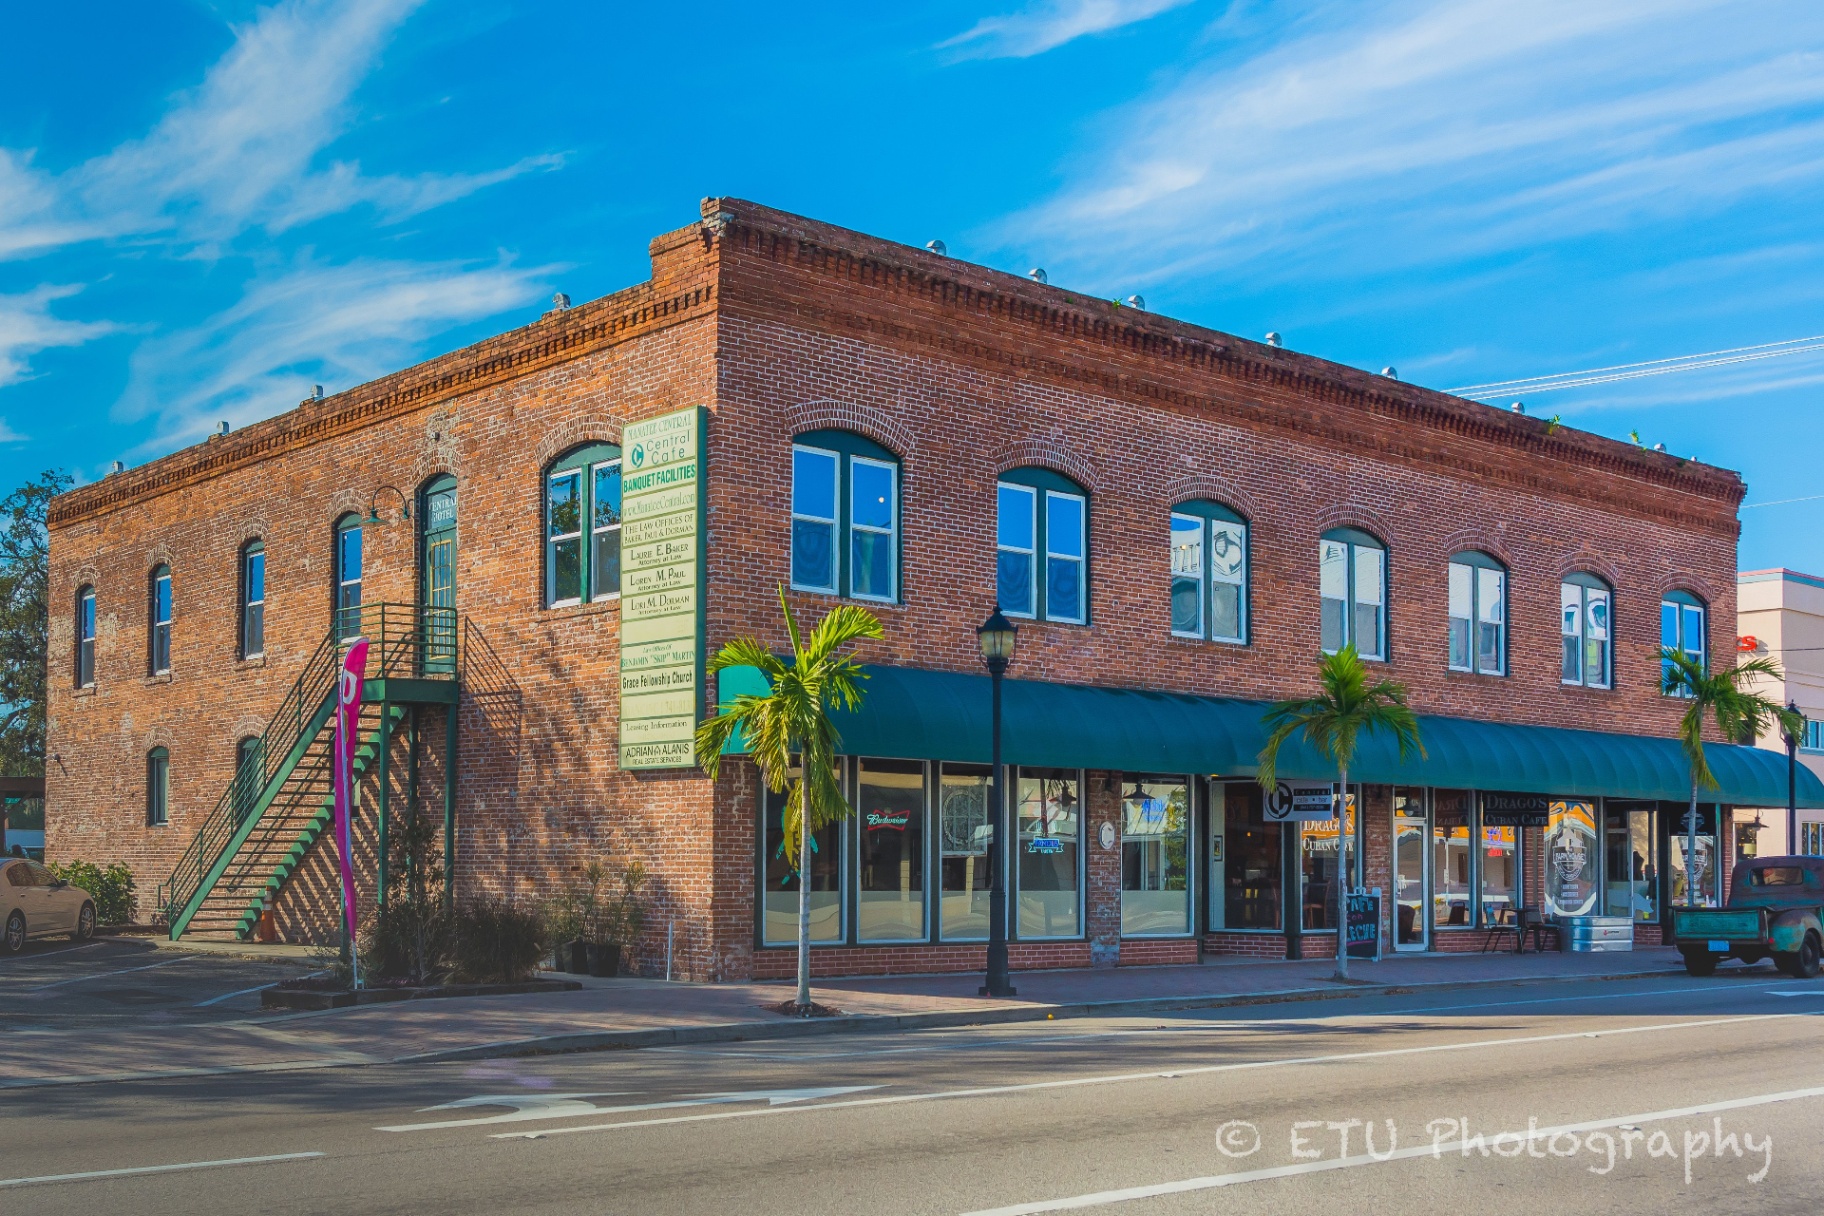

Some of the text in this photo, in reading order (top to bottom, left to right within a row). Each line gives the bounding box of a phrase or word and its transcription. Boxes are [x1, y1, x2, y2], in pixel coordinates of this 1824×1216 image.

[658, 413, 692, 433] CENTRAL
[646, 429, 690, 452] Central
[651, 446, 685, 465] Cafe
[623, 463, 696, 493] BANQUET FACILITIES
[656, 544, 664, 557] E.
[665, 542, 689, 555] BAKER
[638, 558, 661, 567] Attorney
[670, 553, 682, 561] Law
[656, 568, 666, 581] M.
[668, 567, 687, 580] PAUL
[637, 582, 660, 592] Attorney
[621, 656, 649, 668] BENJAMIN
[671, 650, 696, 661] MARTIN
[622, 669, 693, 689] Grace Fellowship Church
[625, 719, 688, 732] Leasing Information
[625, 743, 690, 758] ADRIAN ALANIS
[1486, 794, 1548, 810] DRAGO'S
[1485, 813, 1548, 825] CUBAN CAFE
[1302, 837, 1354, 852] CUBAN CFE
[1346, 923, 1376, 941] ECHE
